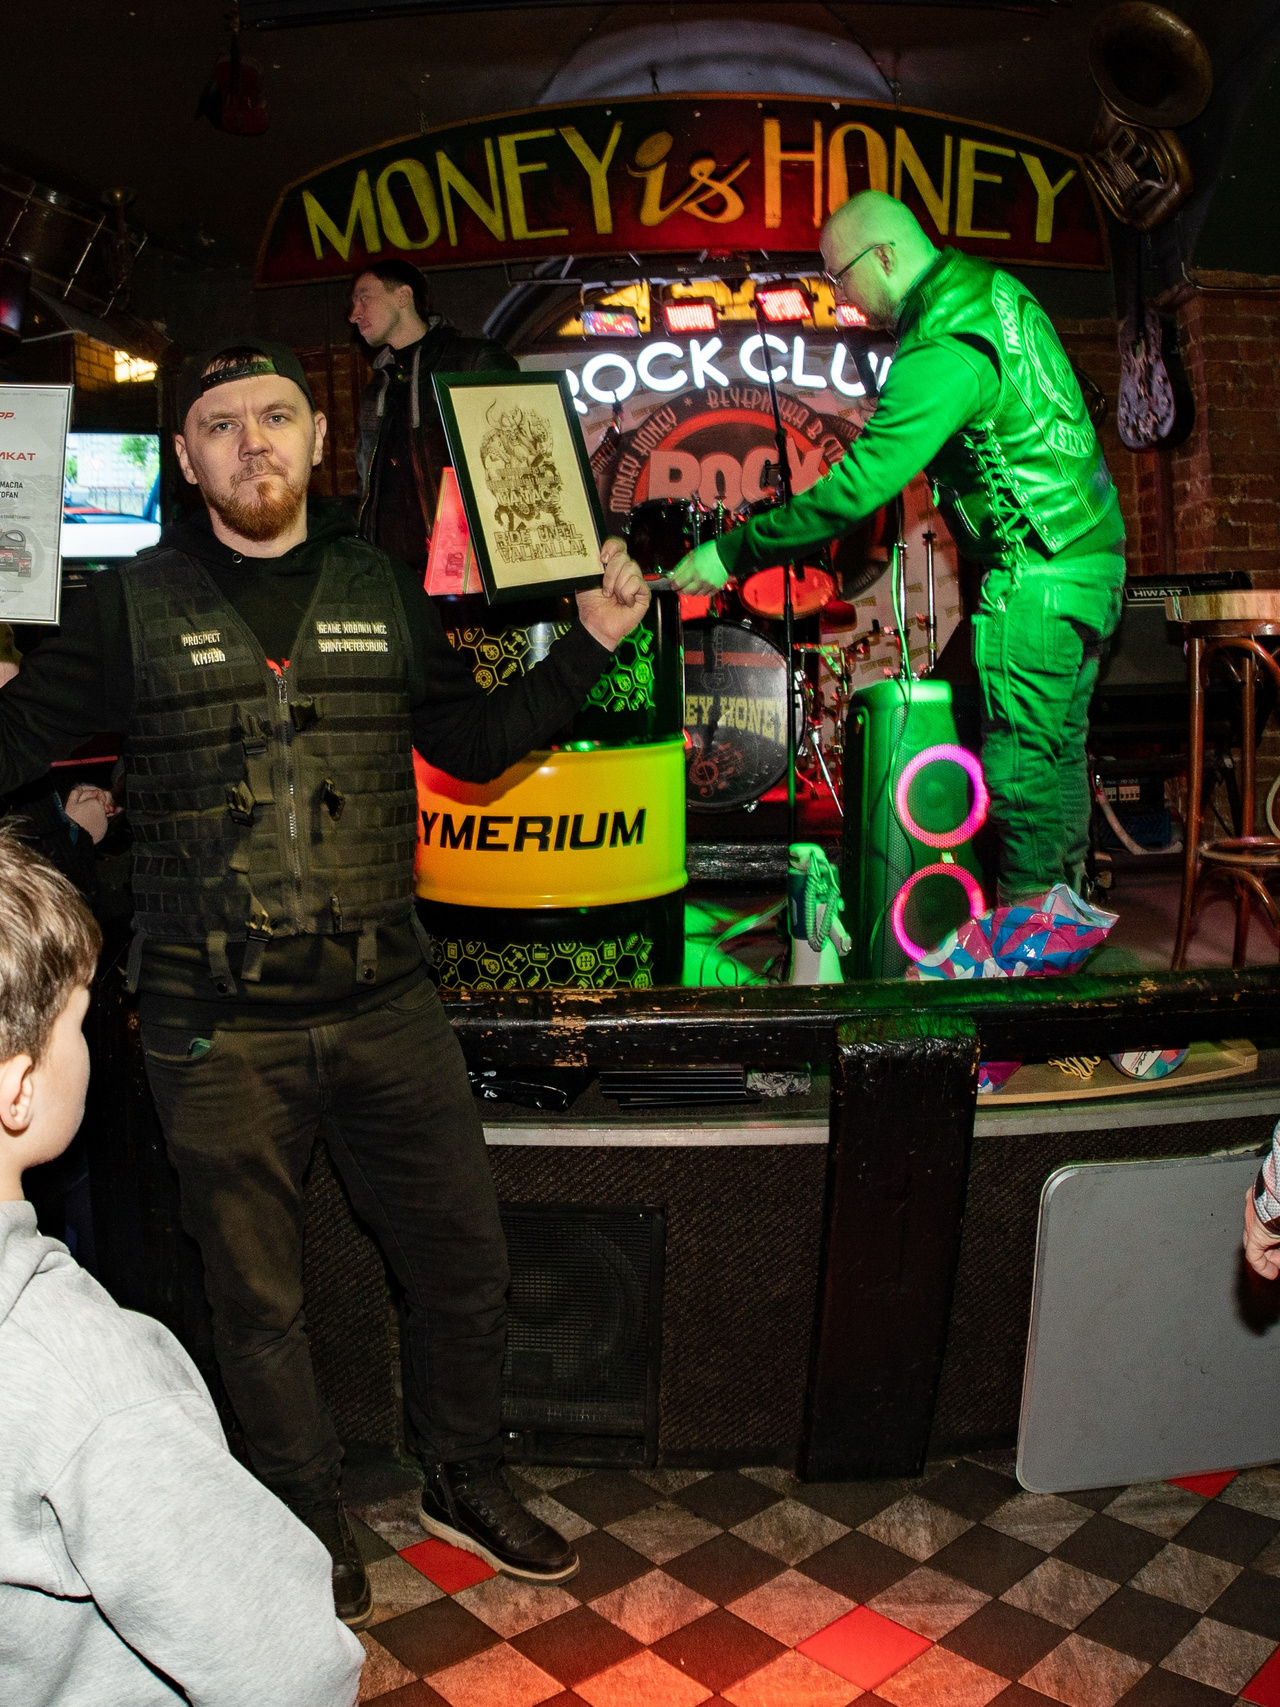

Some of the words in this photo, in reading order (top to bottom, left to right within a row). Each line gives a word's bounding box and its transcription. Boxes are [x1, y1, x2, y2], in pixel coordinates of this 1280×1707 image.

[303, 121, 623, 262] MONEY
[626, 130, 750, 227] is
[764, 117, 1077, 244] HONEY
[631, 405, 679, 457] HONEY
[0, 481, 24, 489] МАСЛА
[494, 529, 532, 547] RIDE
[1133, 589, 1183, 598] HIWATT
[181, 631, 221, 647] PROSPECT
[319, 640, 389, 653] SAINT-PETERSBURG
[191, 649, 226, 666] КНЯЗЬ
[418, 807, 647, 853] YMERIUM
